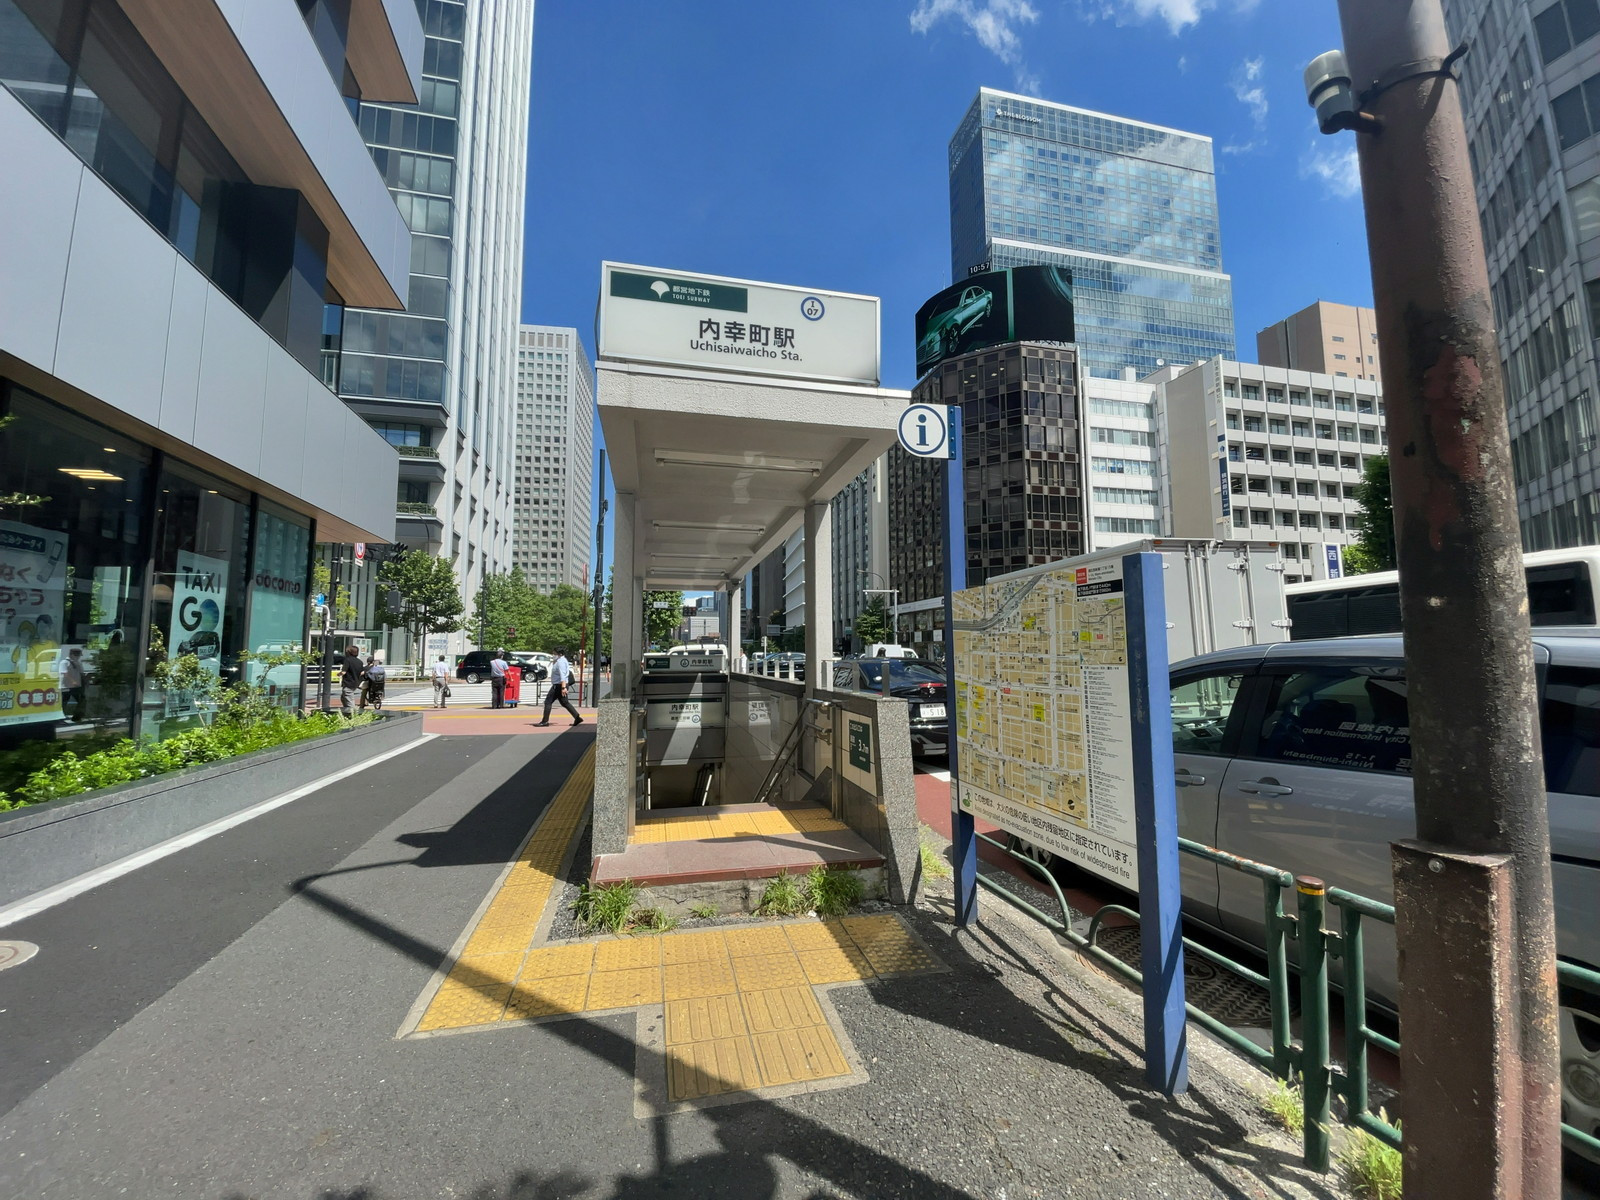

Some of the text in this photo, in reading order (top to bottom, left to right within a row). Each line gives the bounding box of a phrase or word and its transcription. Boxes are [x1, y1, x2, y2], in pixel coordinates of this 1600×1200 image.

[1015, 113, 1041, 123] BLOSSOM
[970, 262, 989, 274] 10:57
[672, 285, 711, 297] 都営地下鉄
[687, 295, 711, 303] SUBWAY
[806, 308, 819, 316] 07
[699, 318, 796, 349] 内幸町駅
[690, 339, 803, 362] Uchisaiwaicho Sta.
[182, 565, 221, 594] TAXI
[256, 573, 301, 594] docomo
[179, 596, 220, 632] GO
[1006, 820, 1033, 836] no-evacuation
[1046, 836, 1055, 846] due
[1055, 840, 1060, 848] to
[1061, 842, 1070, 852] low
[1070, 846, 1080, 857] risk
[1080, 851, 1086, 860] of
[1087, 854, 1119, 875] widespread
[1120, 867, 1130, 879] fire
